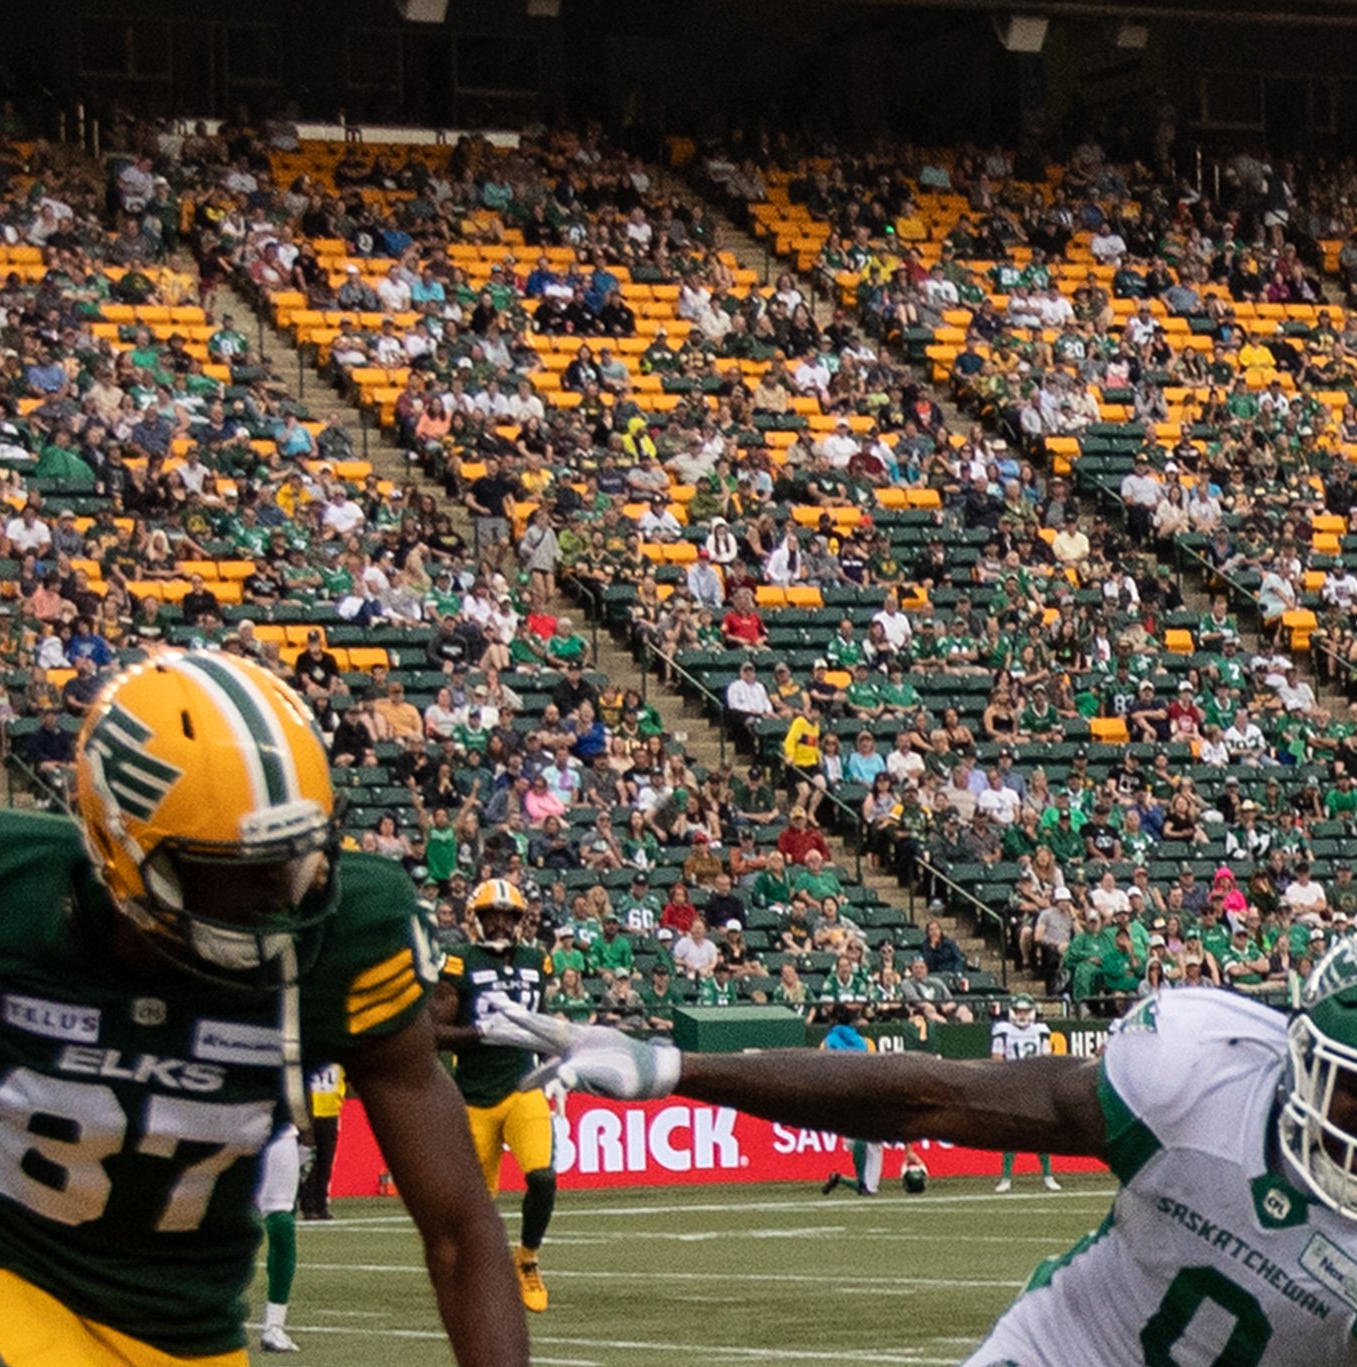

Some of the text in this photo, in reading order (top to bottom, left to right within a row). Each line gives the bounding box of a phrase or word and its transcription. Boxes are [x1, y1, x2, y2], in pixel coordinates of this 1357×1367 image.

[6, 1001, 98, 1032] TELUS
[58, 1045, 227, 1092] ELKS
[1156, 1196, 1331, 1320] SASKATCHEWAN
